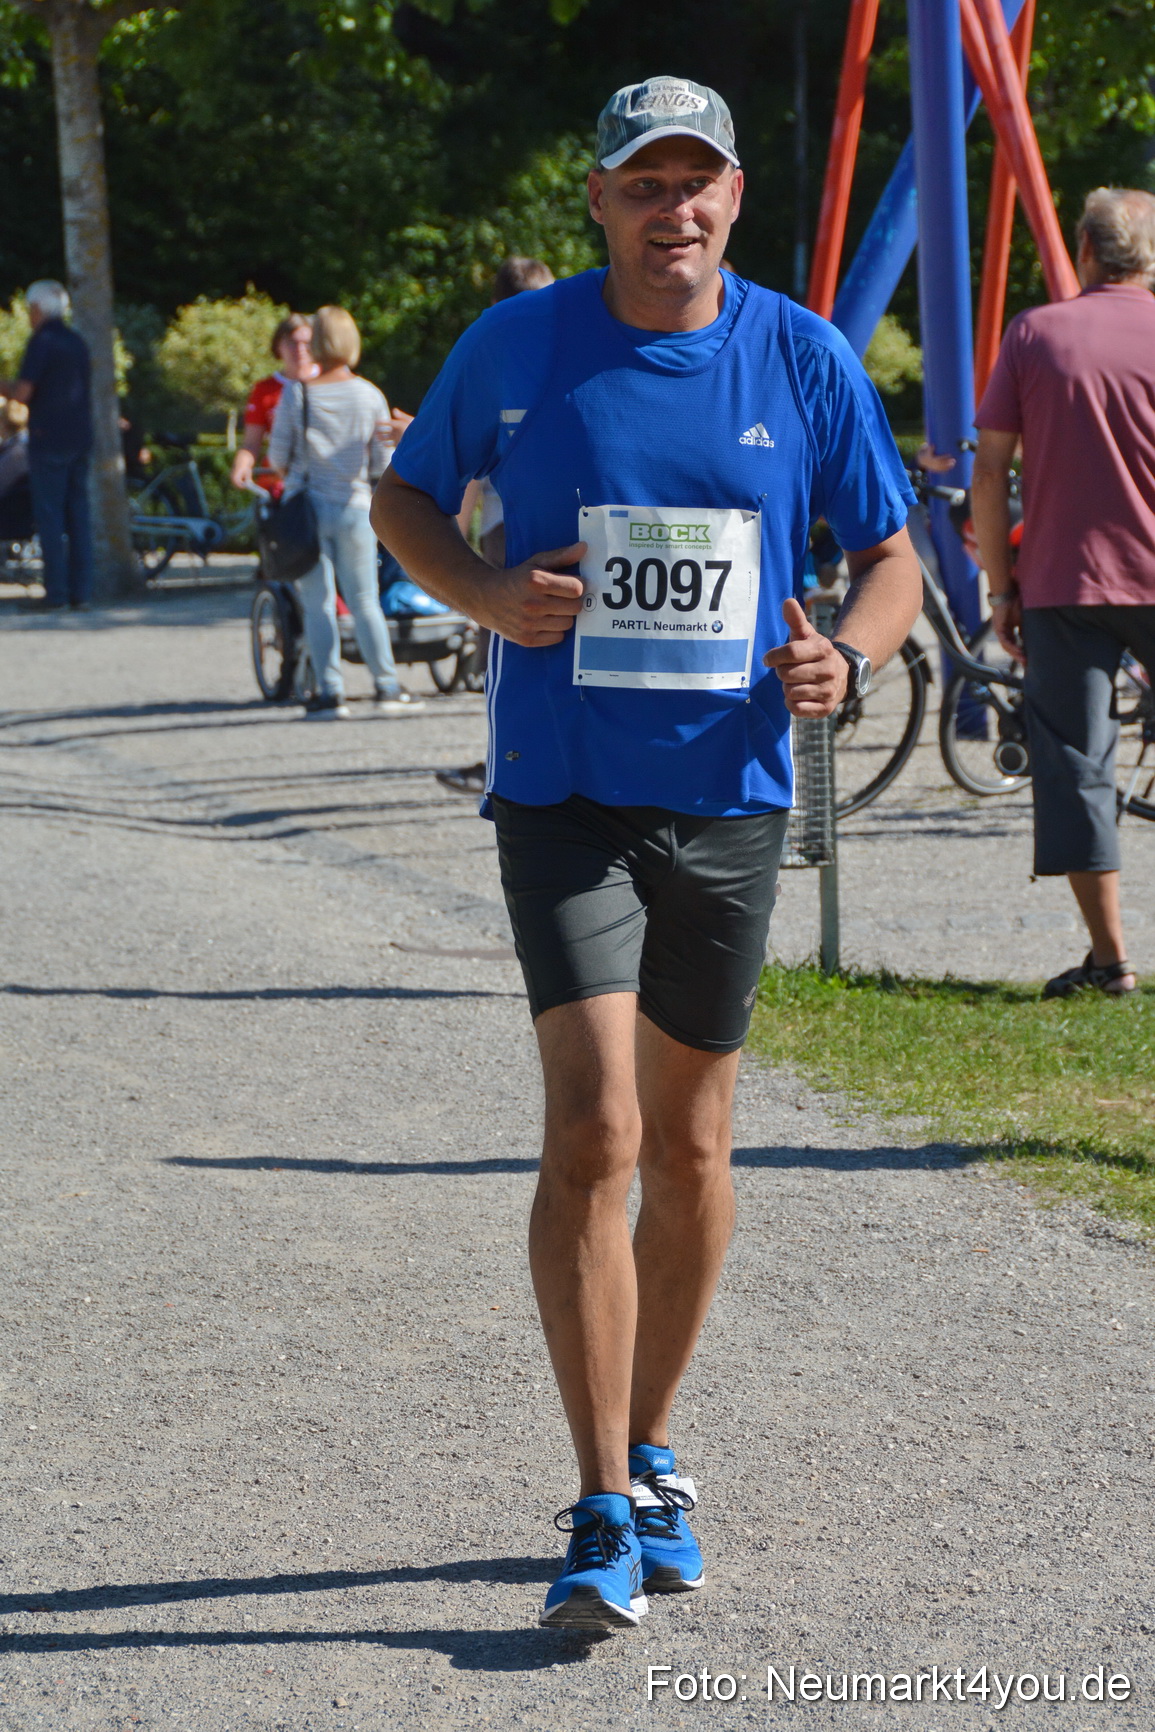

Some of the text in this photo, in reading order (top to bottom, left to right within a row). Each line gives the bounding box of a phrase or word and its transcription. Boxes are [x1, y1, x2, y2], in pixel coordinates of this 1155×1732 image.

[738, 436, 775, 448] adidas
[629, 522, 711, 543] BOCK
[629, 542, 654, 550] inspired
[684, 543, 713, 551] concepts
[602, 556, 733, 612] 3097
[585, 597, 592, 608] D
[611, 619, 651, 631] PARTL
[653, 621, 708, 632] Neumarkt
